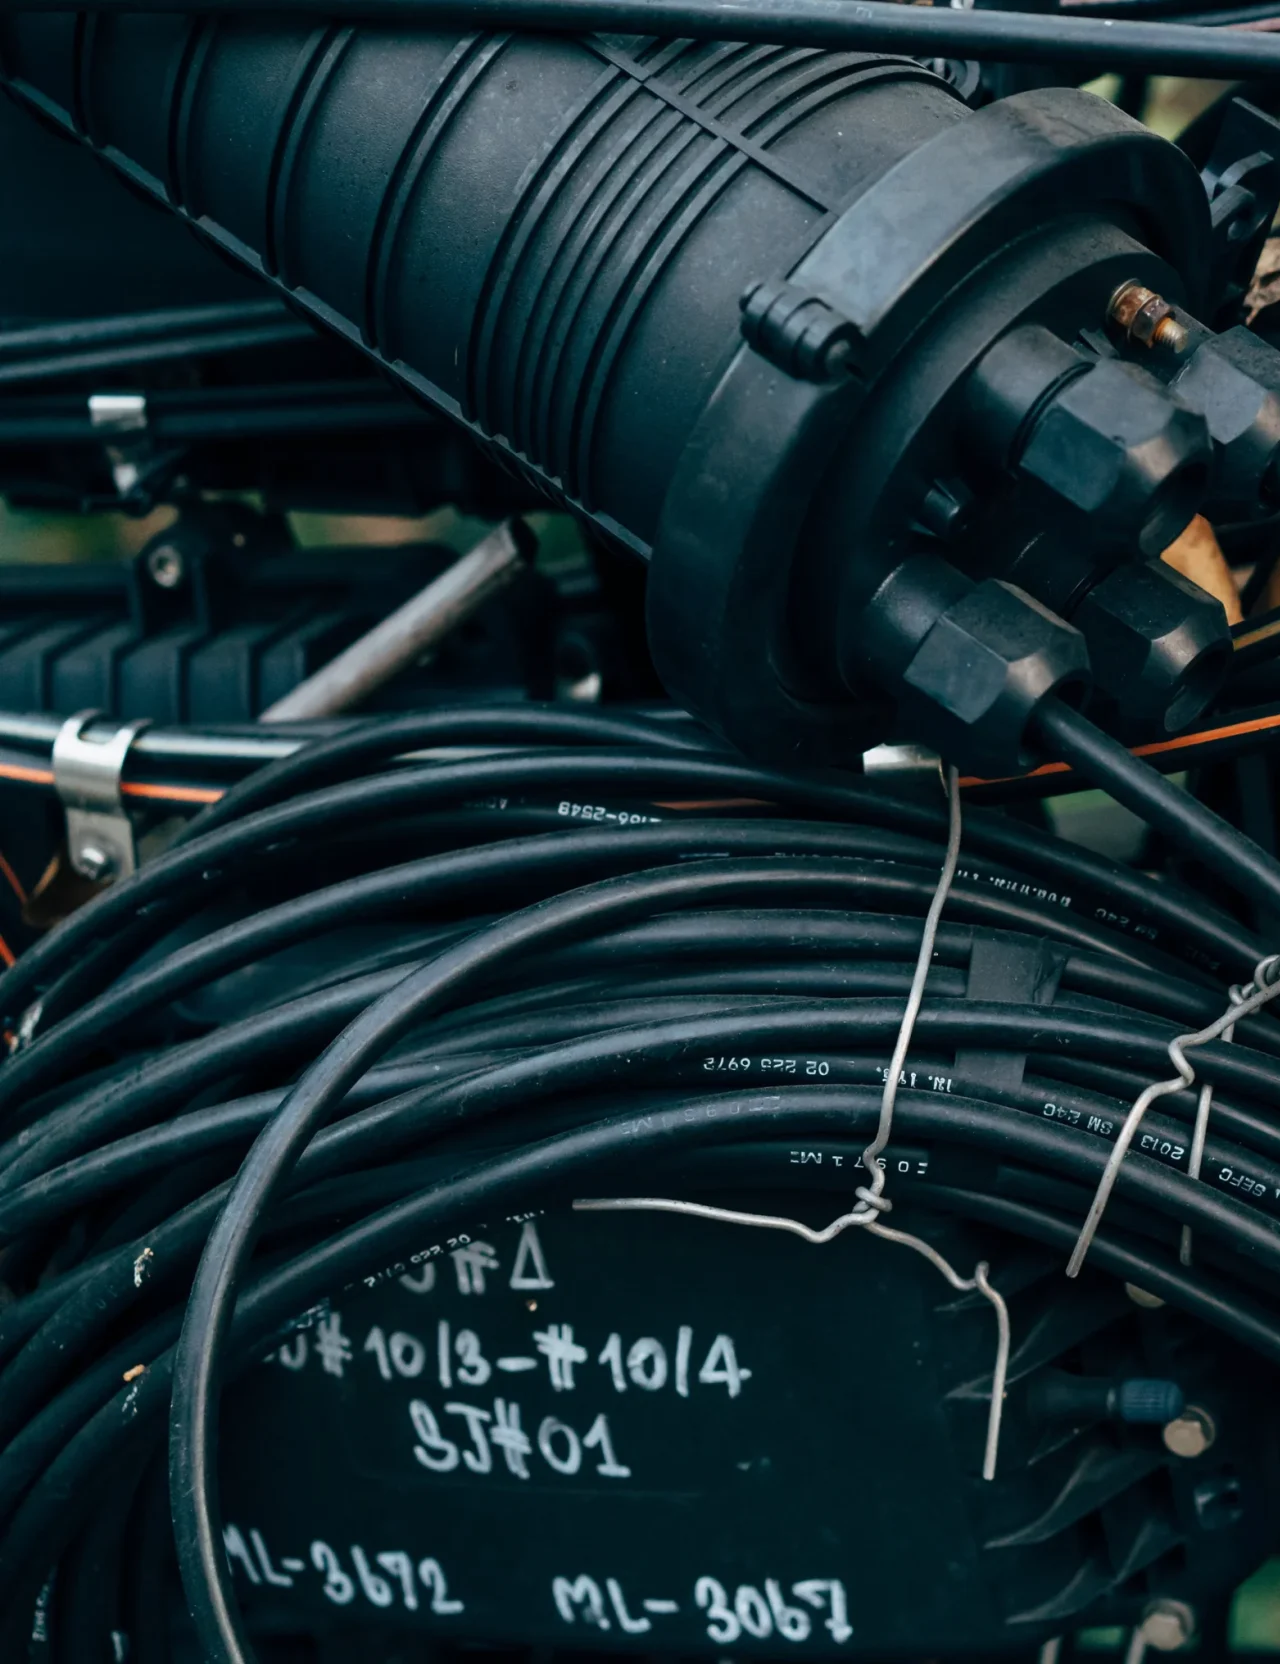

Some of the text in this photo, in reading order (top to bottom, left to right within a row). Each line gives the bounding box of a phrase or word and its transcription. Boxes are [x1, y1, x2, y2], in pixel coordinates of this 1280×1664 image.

[702, 1056, 752, 1072] 6972
[805, 1060, 830, 1076] 02
[1042, 1102, 1082, 1126] 24C
[1087, 1115, 1115, 1136] SM
[1140, 1134, 1186, 1162] 2013
[409, 1396, 632, 1480] SJ#01
